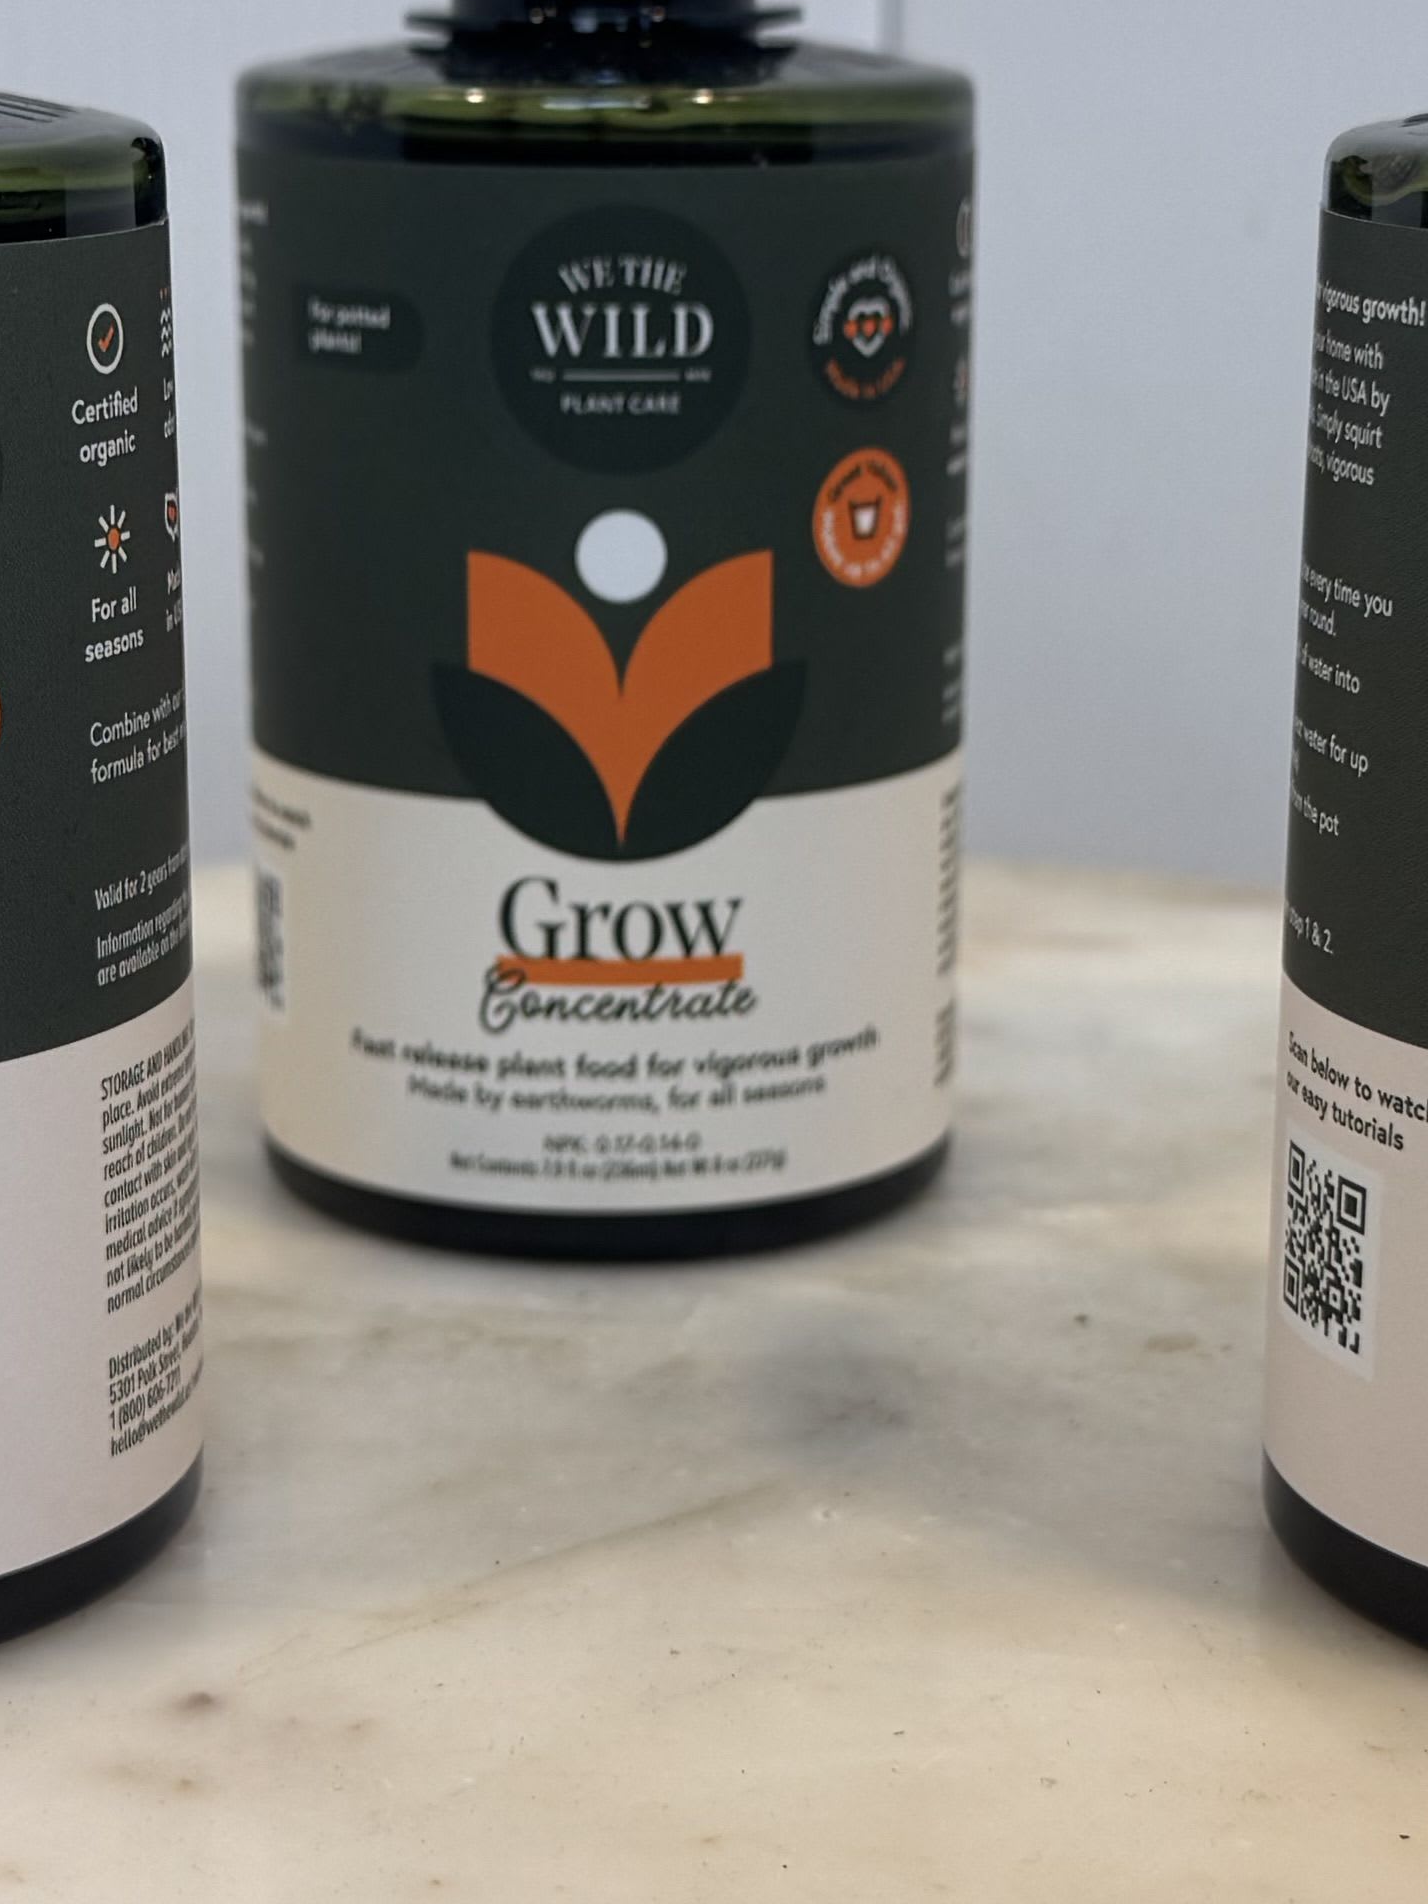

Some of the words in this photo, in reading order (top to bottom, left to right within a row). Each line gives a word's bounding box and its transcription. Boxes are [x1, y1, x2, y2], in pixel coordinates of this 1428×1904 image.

[558, 256, 614, 293] WE
[619, 255, 687, 295] THE
[531, 302, 714, 358] WILD
[1362, 296, 1426, 327] growth!
[1354, 341, 1383, 370] with
[72, 386, 137, 425] Certified
[1341, 375, 1367, 406] USA
[1371, 381, 1390, 417] by
[80, 429, 136, 467] organic
[1344, 422, 1382, 450] squirt
[1326, 450, 1375, 486] vigorous
[91, 598, 117, 623] For
[122, 586, 137, 614] all
[1334, 578, 1361, 608] time
[1364, 593, 1393, 618] you
[85, 629, 144, 663] seasons
[1335, 663, 1360, 694] into
[90, 712, 150, 747] Combine
[91, 745, 144, 784] formula
[147, 738, 161, 763] for
[1329, 734, 1347, 764] for
[1350, 751, 1369, 778] up
[1319, 812, 1339, 836] pot
[95, 881, 123, 911] Valid
[124, 877, 138, 900] for
[139, 870, 146, 893] 2
[499, 875, 743, 962] Grow
[97, 919, 153, 959] Information
[97, 964, 117, 986] are
[119, 940, 160, 978] available
[478, 962, 759, 1035] Concentrate
[351, 1026, 396, 1059] Fast
[402, 1041, 489, 1075] release
[497, 1049, 565, 1081] plant
[575, 1050, 635, 1080] food
[645, 1050, 685, 1078] for
[692, 1046, 800, 1080] vigorous
[807, 1025, 879, 1067] growth
[101, 1060, 145, 1101] STORAGE
[407, 1073, 468, 1104] Made
[475, 1082, 506, 1112] by
[667, 1085, 701, 1109] for
[708, 1081, 737, 1106] all
[743, 1073, 826, 1104] seasons
[1311, 1047, 1350, 1091] below
[1355, 1076, 1372, 1101] to
[102, 1100, 134, 1133] place.
[137, 1077, 160, 1111] Avoid
[1302, 1085, 1329, 1121] easy
[1332, 1101, 1405, 1152] tutorials
[103, 1117, 147, 1155] sunlight.
[104, 1149, 134, 1181] reach
[104, 1172, 142, 1208] contact
[106, 1221, 146, 1261] medical
[107, 1260, 125, 1288] not
[108, 1275, 144, 1314] normal
[109, 1328, 161, 1379] Distributed
[109, 1372, 135, 1405] 5301
[119, 1393, 146, 1431] (800)
